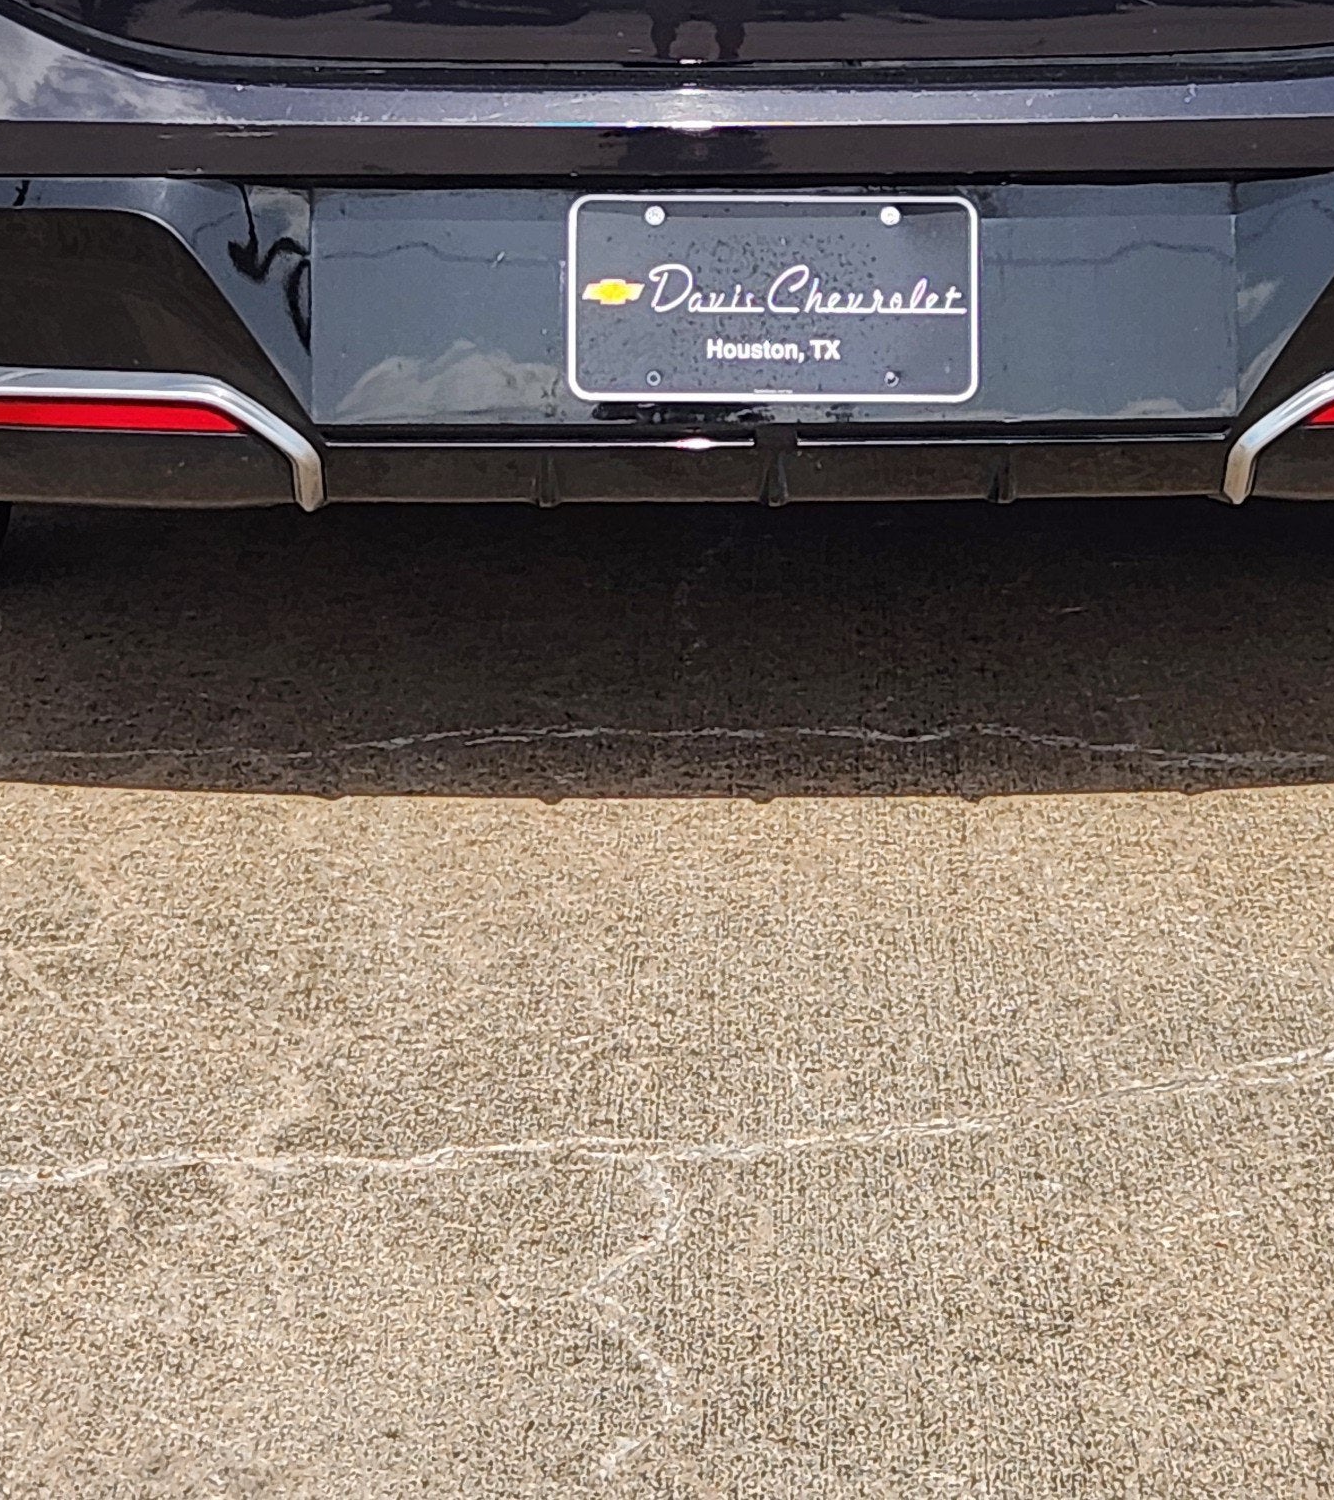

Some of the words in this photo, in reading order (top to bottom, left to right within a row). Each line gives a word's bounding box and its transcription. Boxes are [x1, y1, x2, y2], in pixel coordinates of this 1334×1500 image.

[649, 263, 764, 313] Davis
[768, 264, 967, 314] Chevrolet
[706, 339, 805, 362] Houston,
[810, 340, 841, 361] TX
